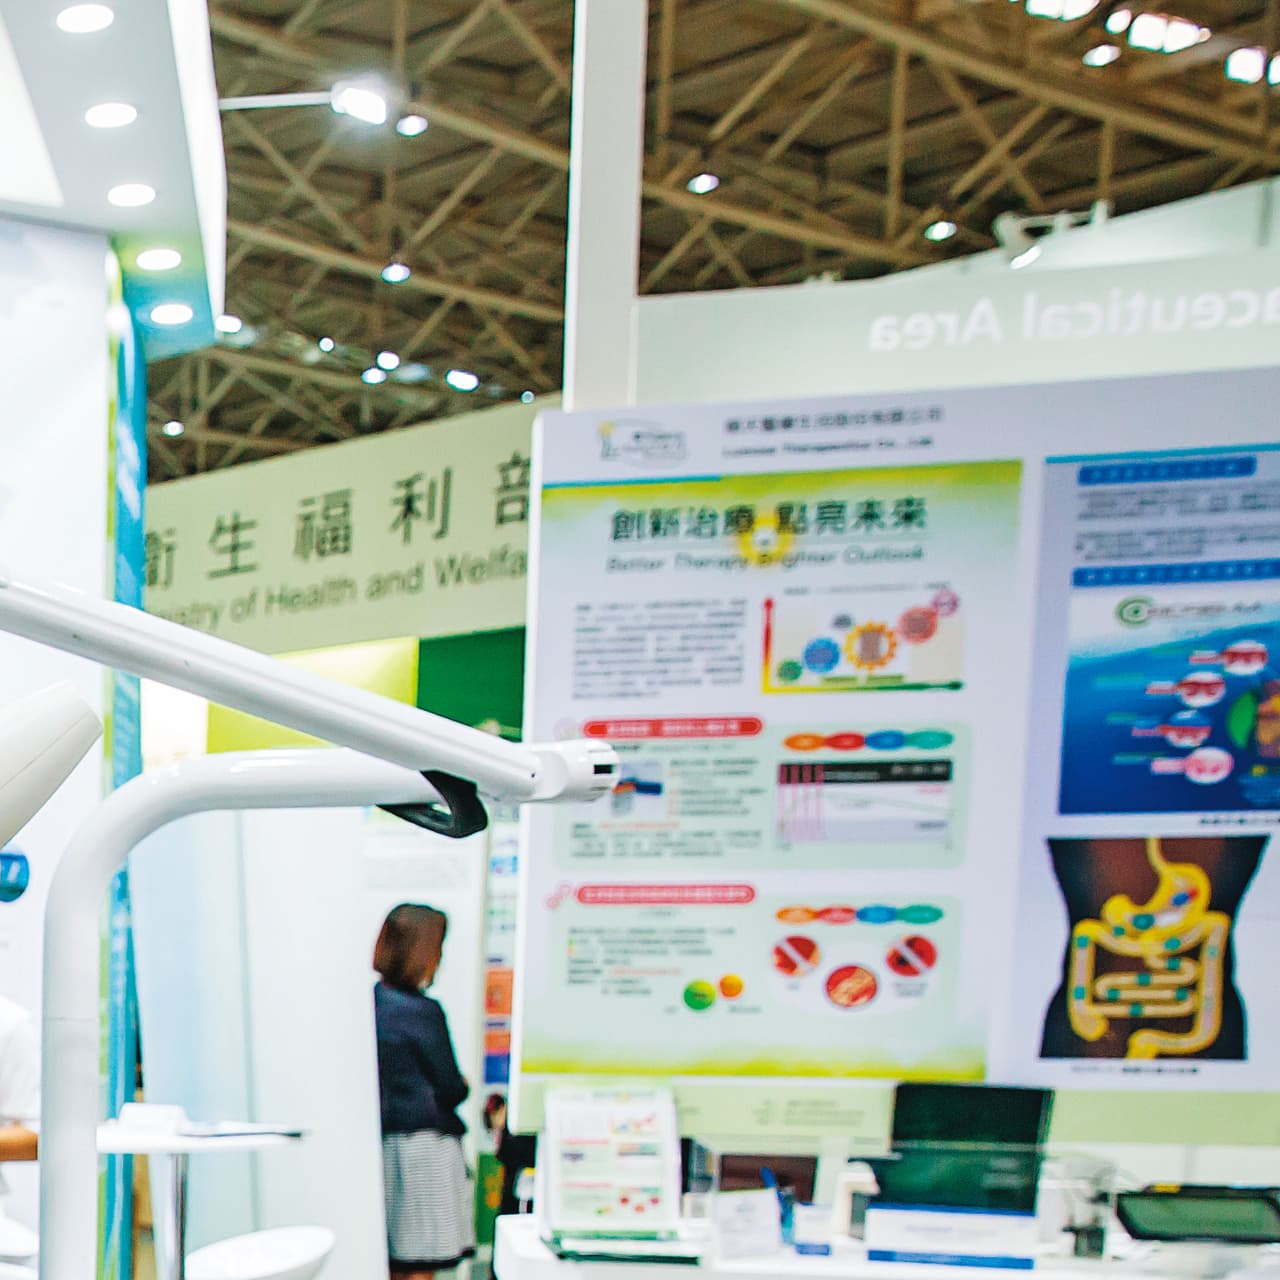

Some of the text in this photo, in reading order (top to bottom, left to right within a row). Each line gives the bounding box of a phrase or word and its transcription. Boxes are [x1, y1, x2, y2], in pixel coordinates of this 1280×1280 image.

[774, 494, 929, 537] 點亮未來
[366, 560, 426, 602] and
